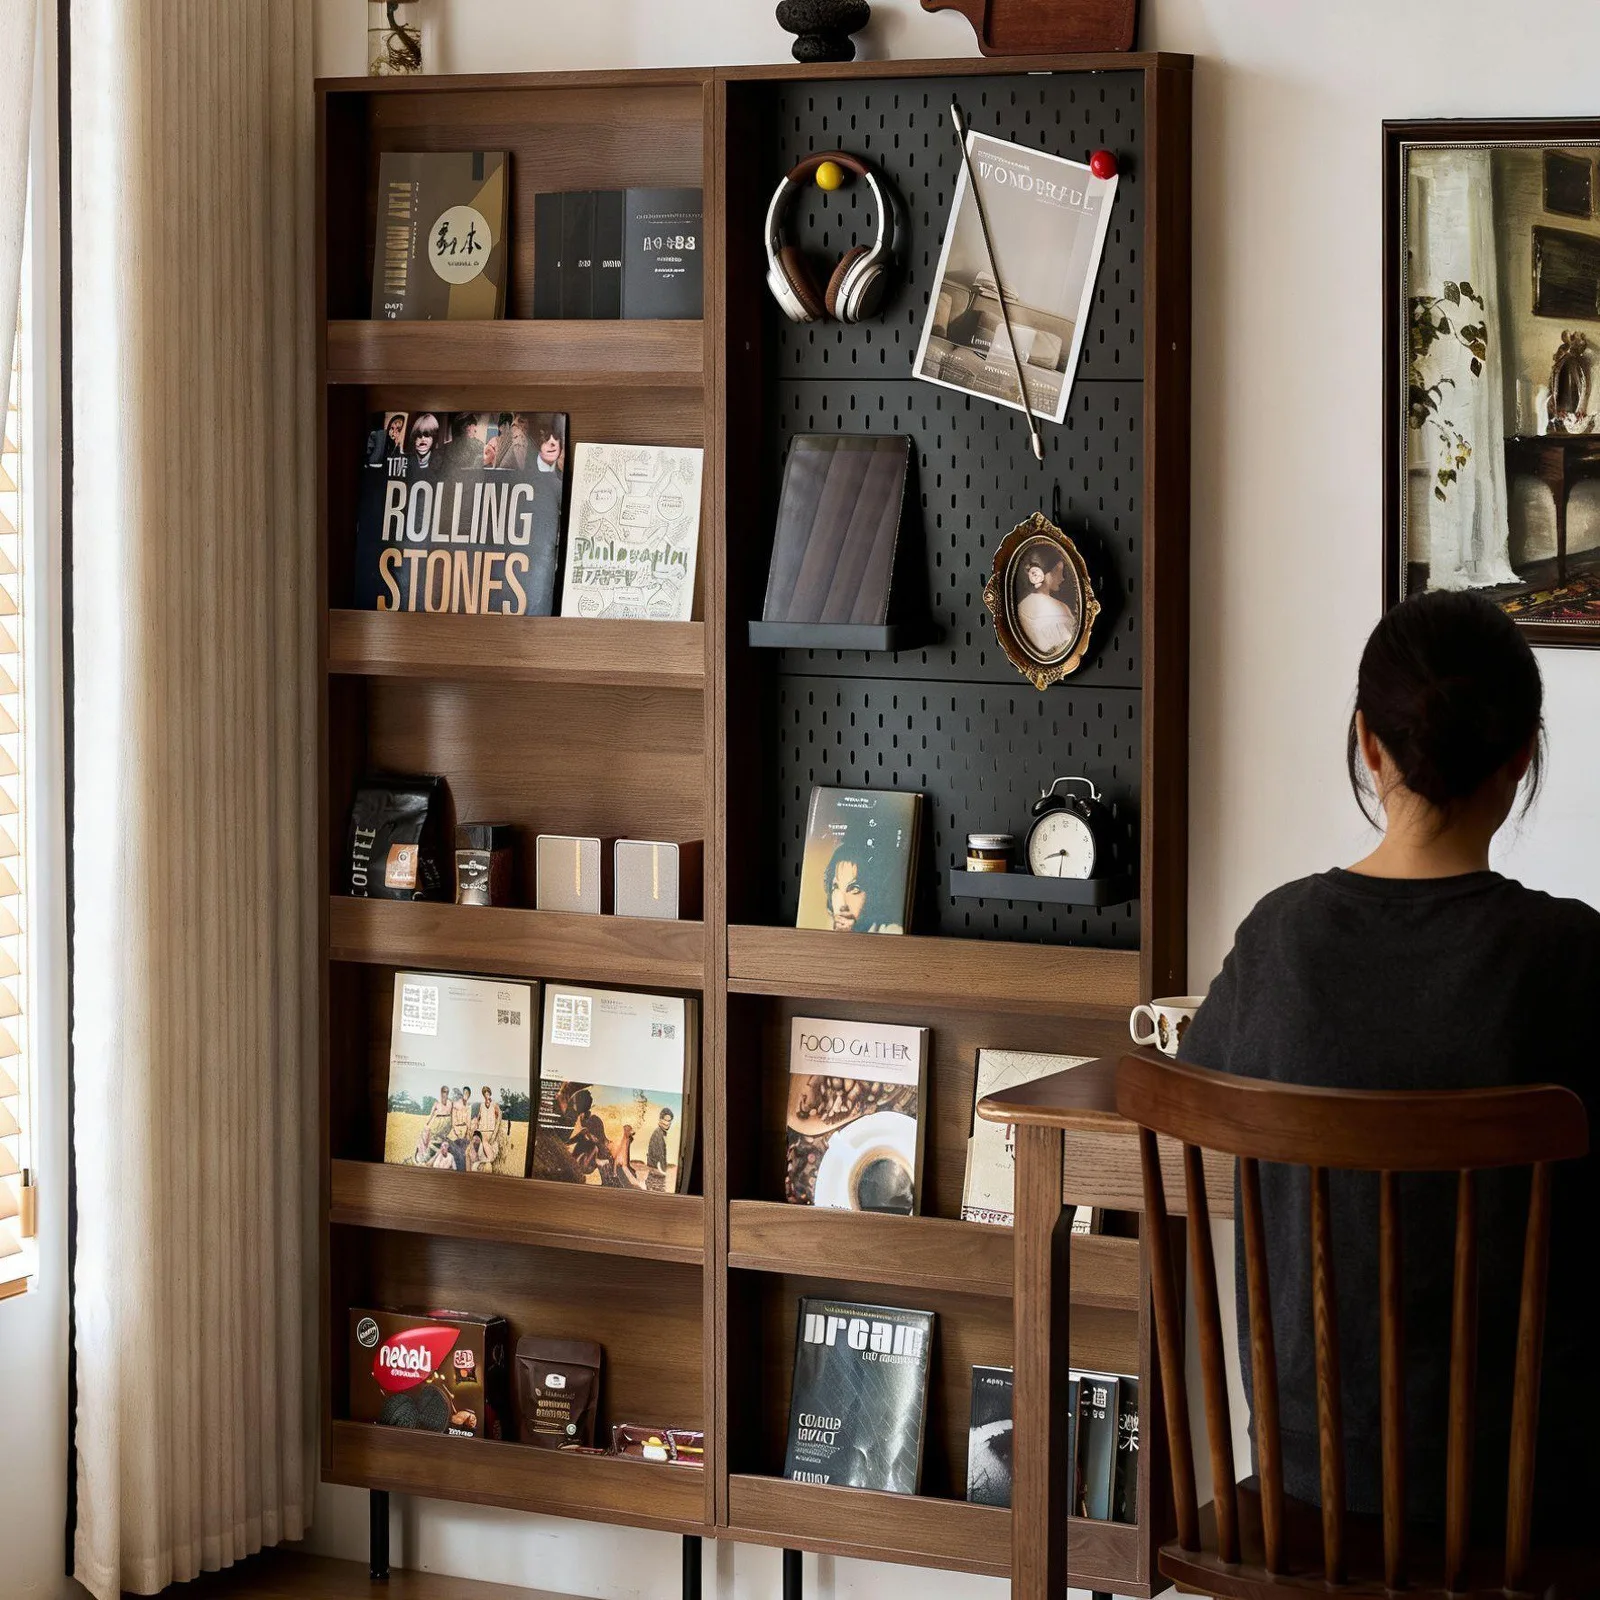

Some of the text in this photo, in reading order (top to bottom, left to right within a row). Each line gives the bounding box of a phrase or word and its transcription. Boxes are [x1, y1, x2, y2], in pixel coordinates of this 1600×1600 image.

[381, 479, 535, 546] ROLLING
[376, 547, 530, 616] STONES
[800, 1033, 912, 1061] FOOD GATHER
